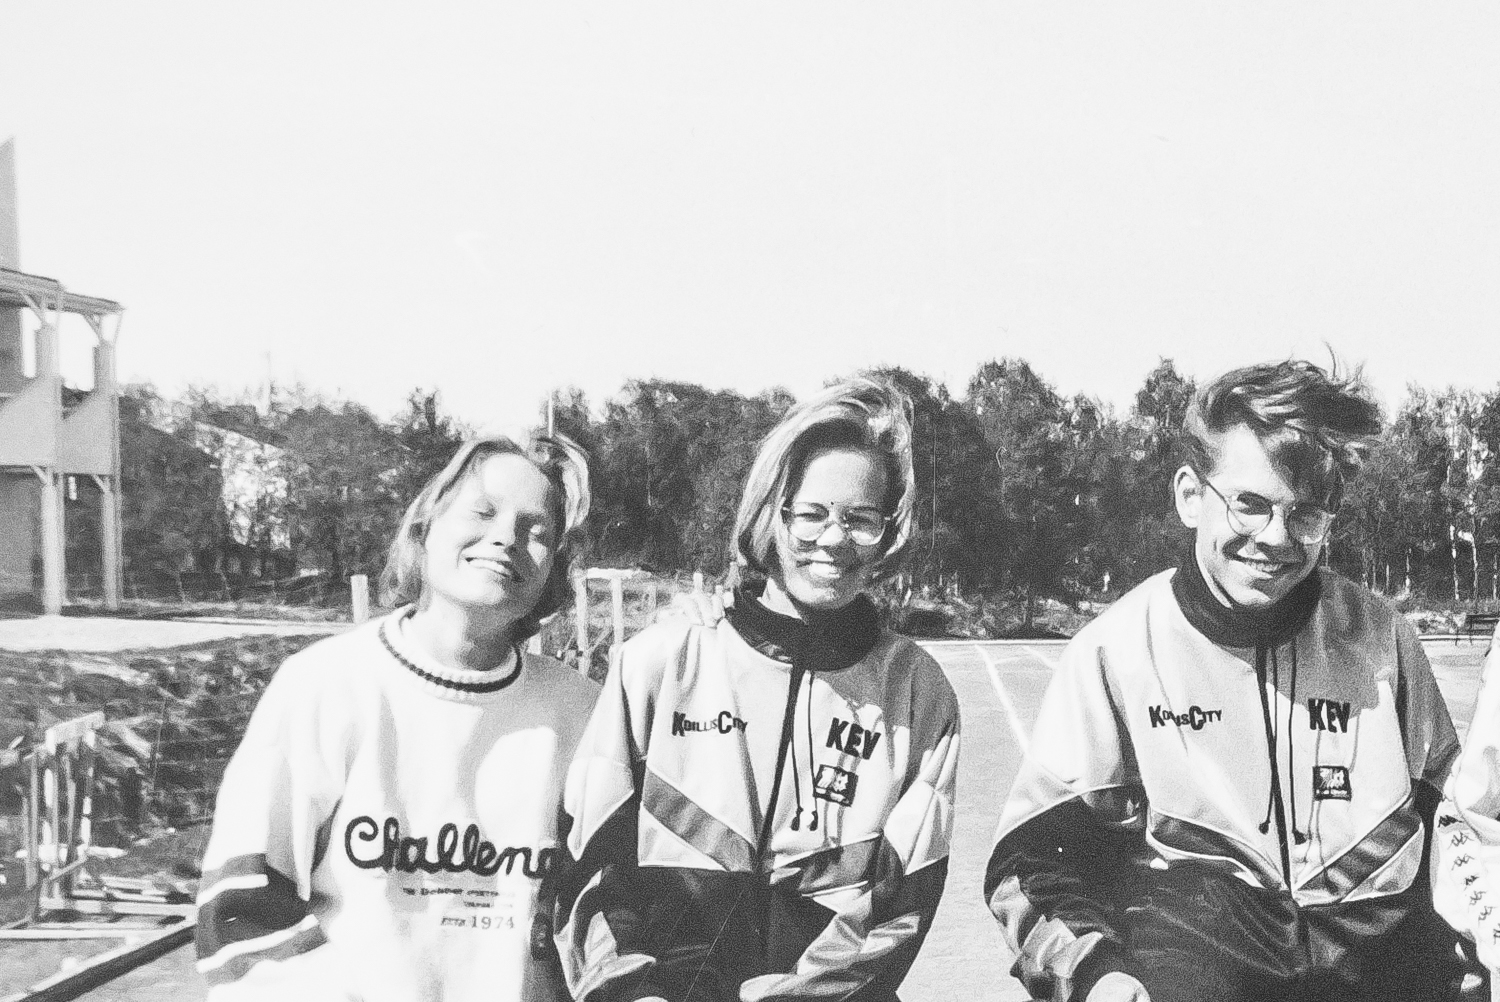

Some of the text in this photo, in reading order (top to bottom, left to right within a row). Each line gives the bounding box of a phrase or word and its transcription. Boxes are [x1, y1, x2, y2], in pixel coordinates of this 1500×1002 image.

[1308, 699, 1350, 733] KEV
[825, 716, 882, 760] KEV
[470, 914, 516, 931] 1974
